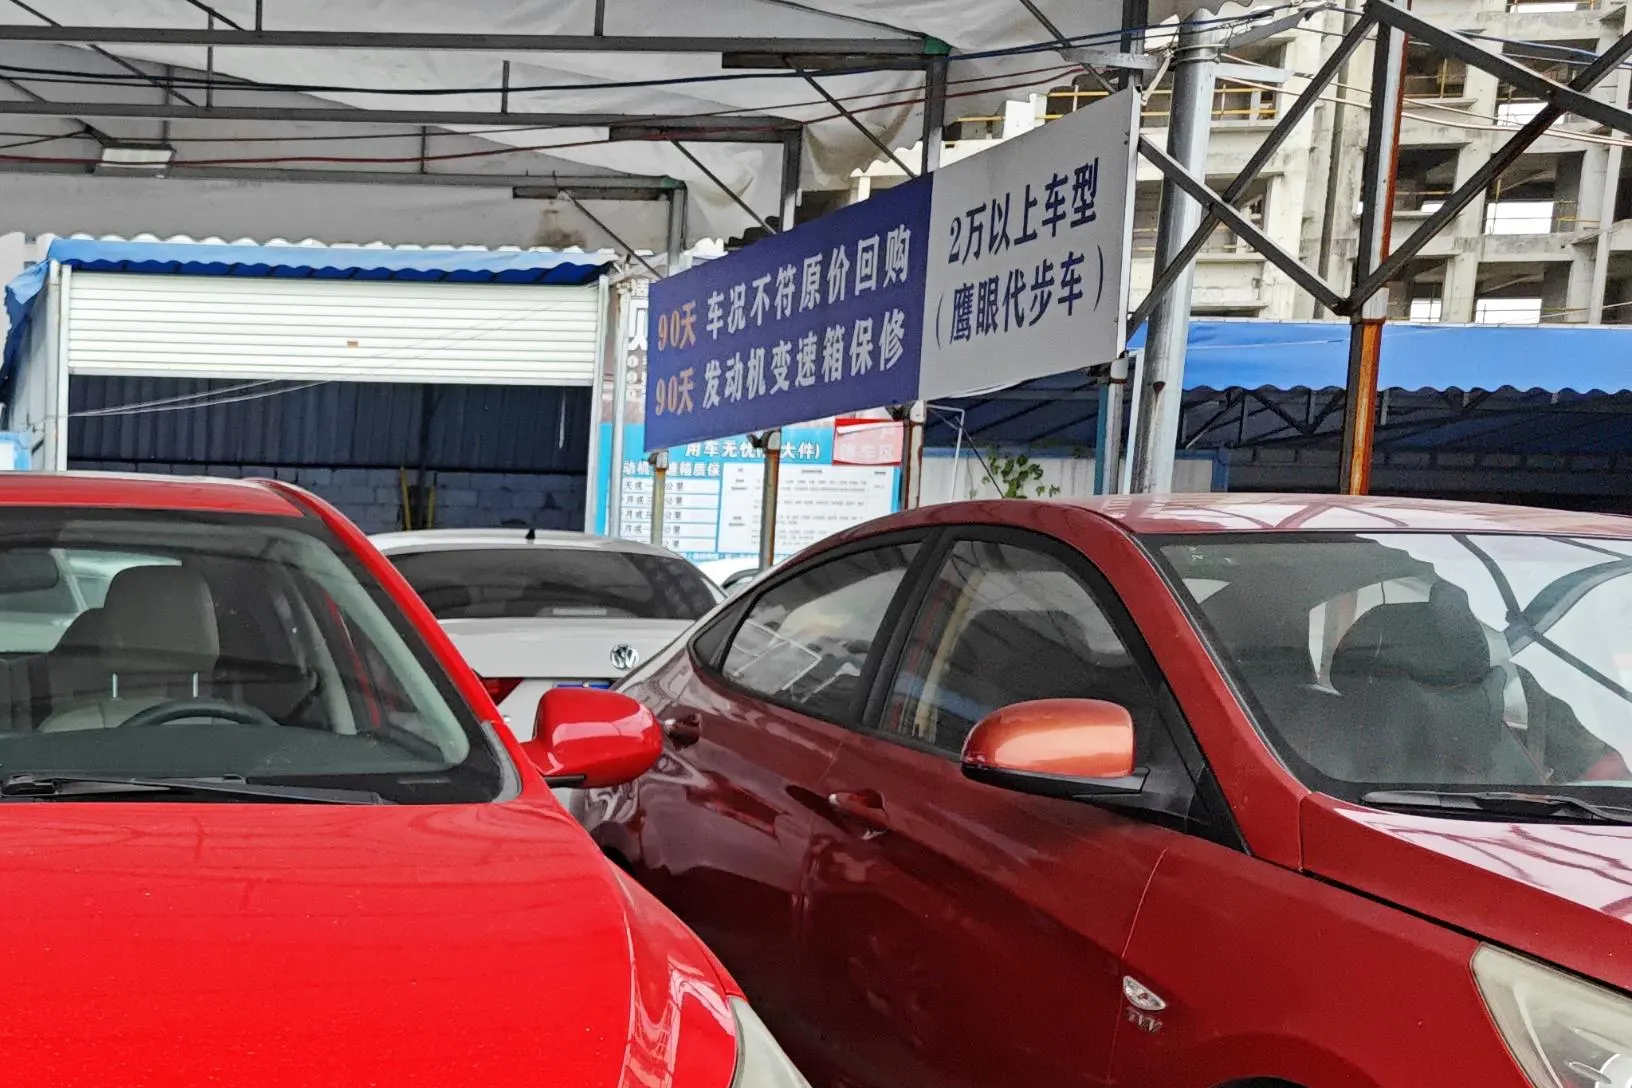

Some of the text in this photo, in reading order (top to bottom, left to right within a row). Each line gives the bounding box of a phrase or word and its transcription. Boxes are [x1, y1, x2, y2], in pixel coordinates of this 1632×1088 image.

[948, 158, 1100, 264] 2万以上车型
[657, 301, 697, 353] 90天
[706, 224, 912, 341] 车况不符原价回购
[655, 367, 695, 417] 90天
[703, 310, 906, 408] 发动机变速箱保修
[686, 438, 821, 461] 用车无忧(大件)
